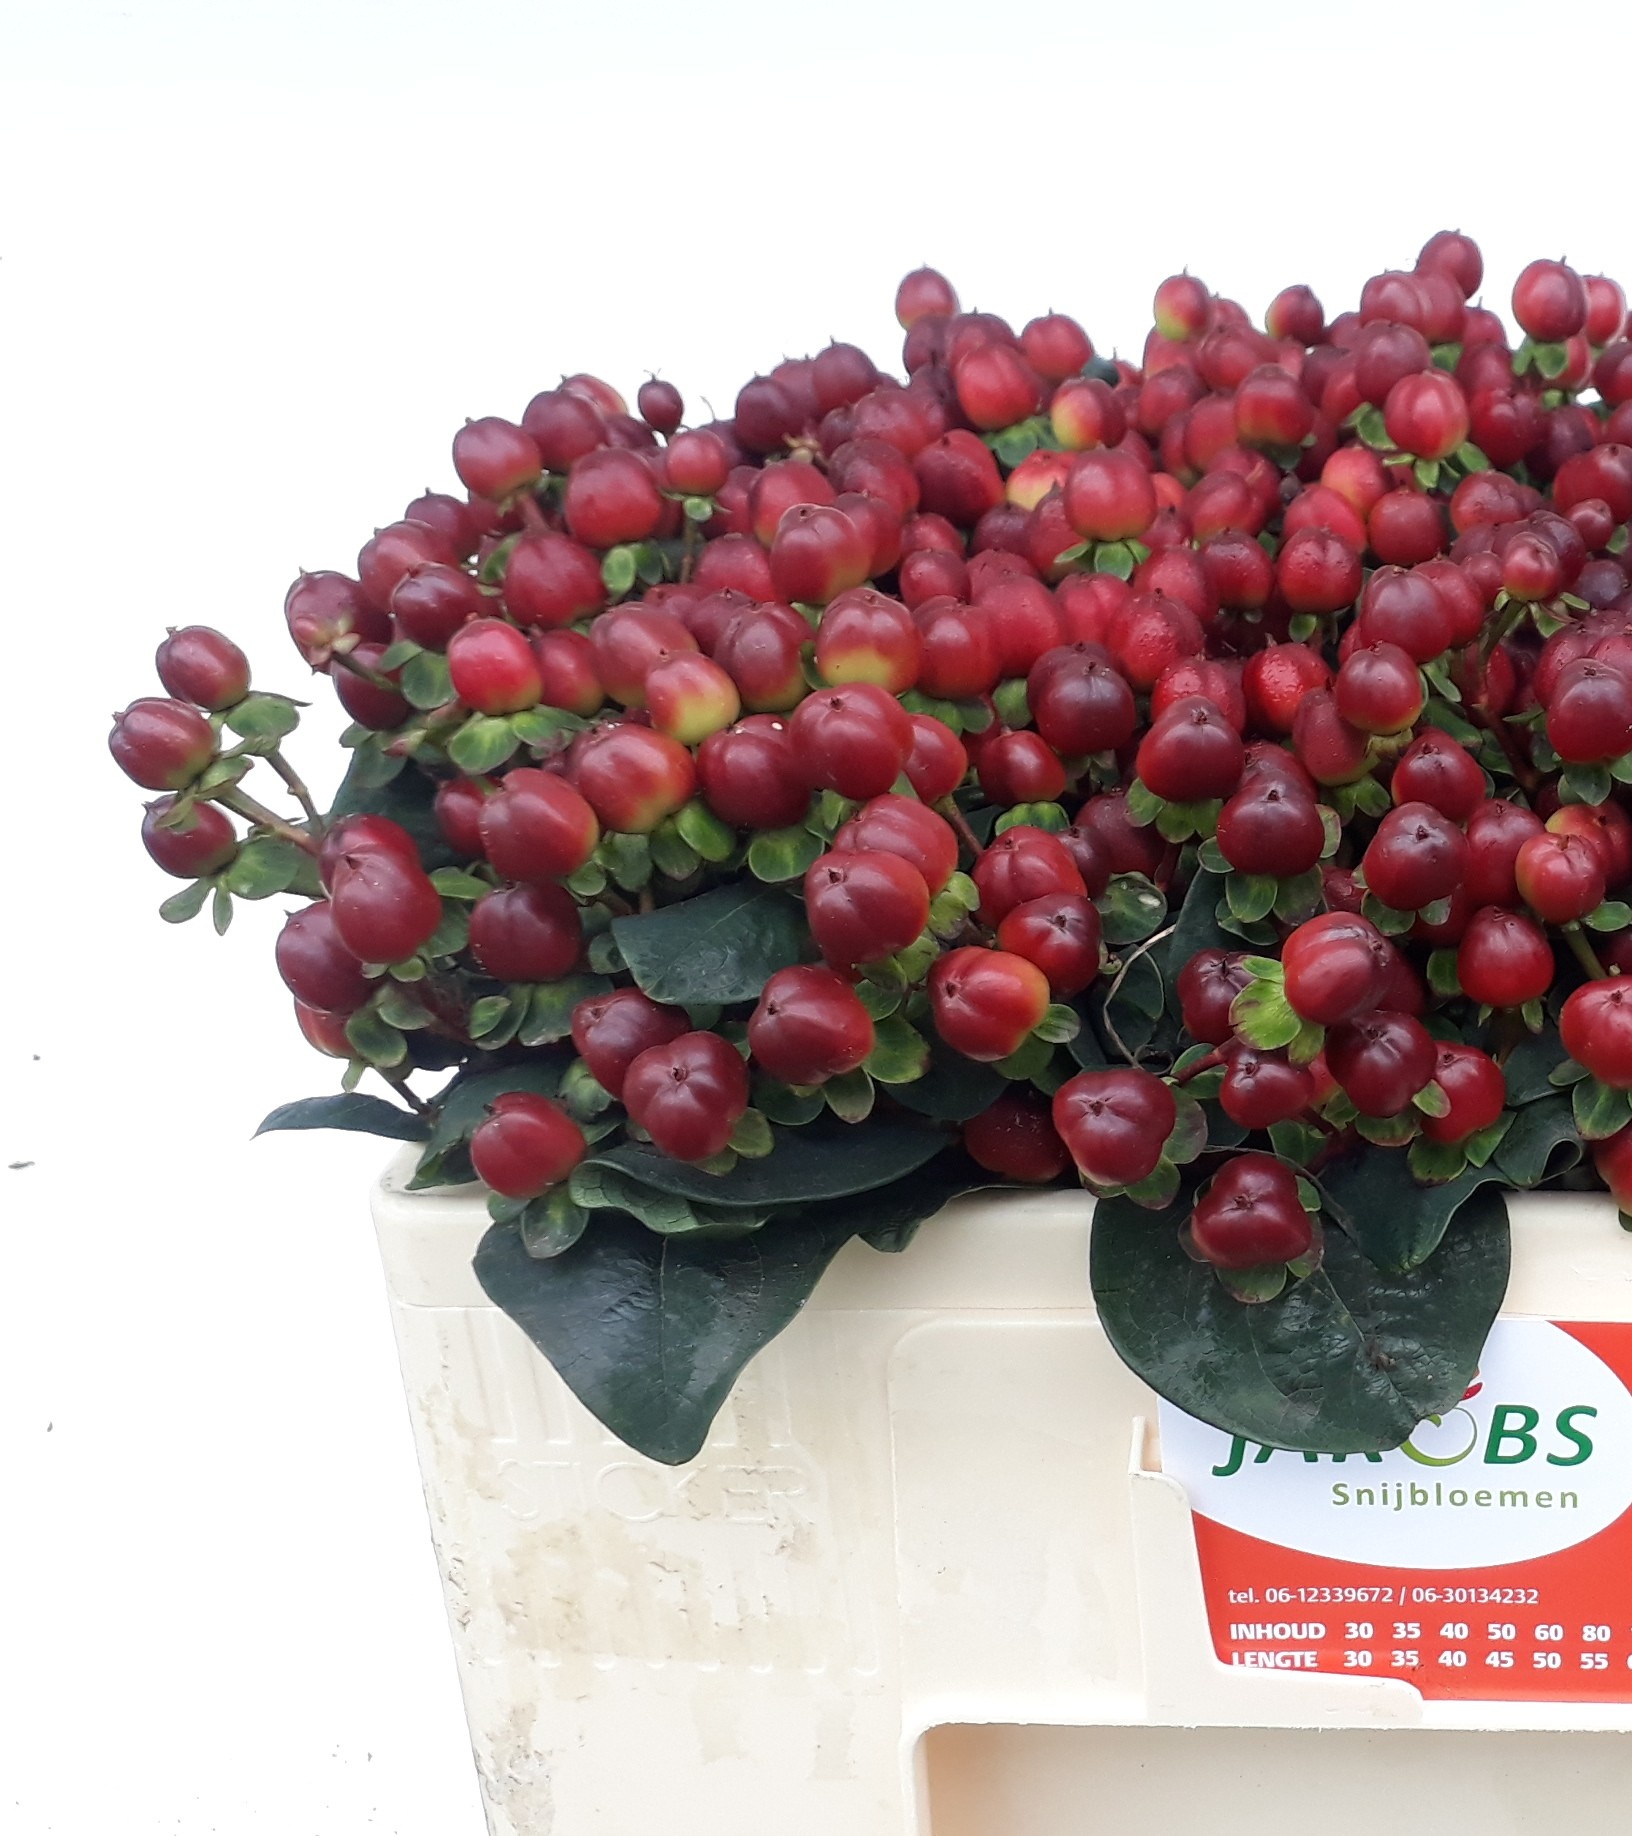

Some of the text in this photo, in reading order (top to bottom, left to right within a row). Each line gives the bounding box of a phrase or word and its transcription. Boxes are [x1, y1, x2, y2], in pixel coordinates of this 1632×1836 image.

[1212, 1404, 1598, 1477] JOBS
[1331, 1482, 1579, 1511] Snijbloemen
[1228, 1586, 1539, 1607] tel. 06-12339672 / 06-30134232
[1229, 1622, 1327, 1641] INHOUD
[1344, 1622, 1374, 1640] 30
[1392, 1622, 1422, 1640] 35
[1439, 1622, 1469, 1641] 40
[1487, 1623, 1517, 1642] 50
[1534, 1624, 1564, 1642] 60
[1581, 1624, 1611, 1643] 80
[1231, 1650, 1318, 1668] LENGTE
[1343, 1650, 1373, 1667] 30
[1391, 1650, 1420, 1667] 35
[1437, 1650, 1468, 1668] 40
[1484, 1651, 1515, 1669] 45
[1532, 1652, 1562, 1669] 50
[1579, 1652, 1609, 1671] 55
